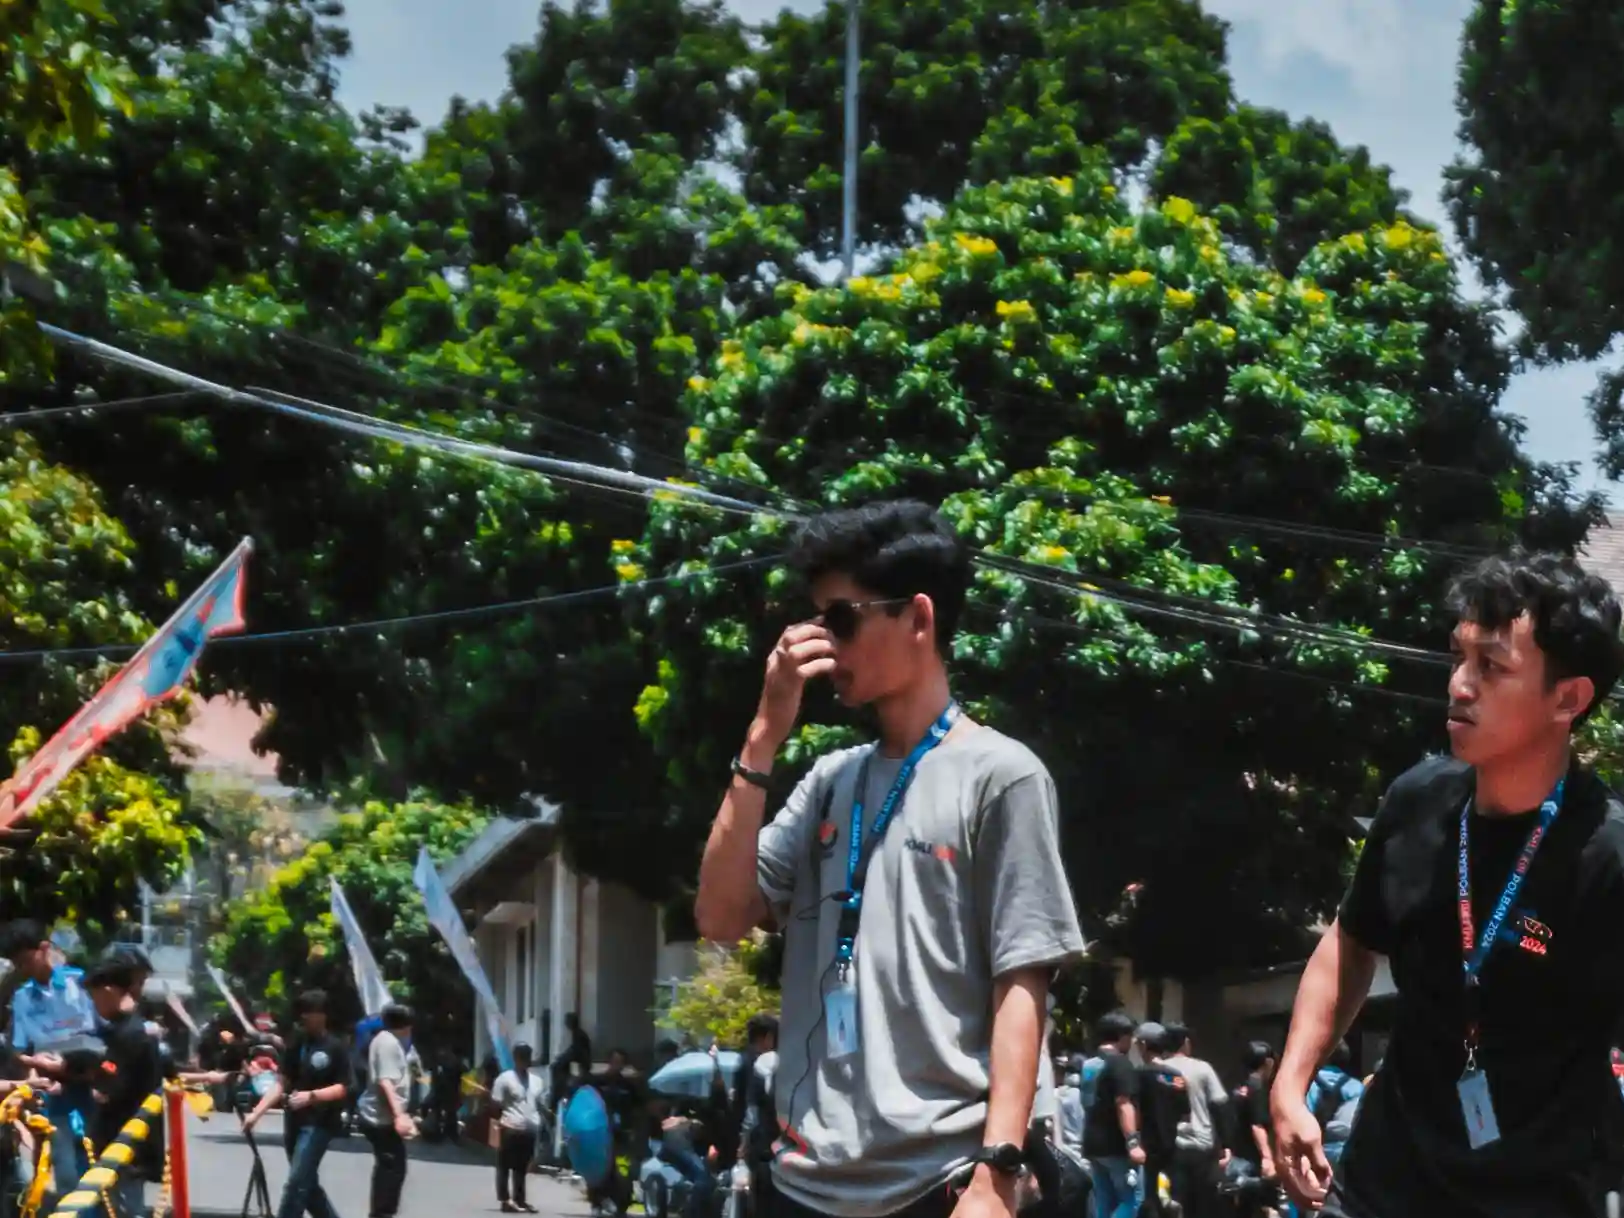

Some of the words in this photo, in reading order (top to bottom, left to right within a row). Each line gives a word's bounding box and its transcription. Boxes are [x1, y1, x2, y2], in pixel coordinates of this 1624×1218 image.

[1458, 850, 1470, 897] POLBAN
[1495, 873, 1522, 922] POLBAN
[1480, 920, 1499, 948] 2024
[1519, 935, 1548, 956] 2024
